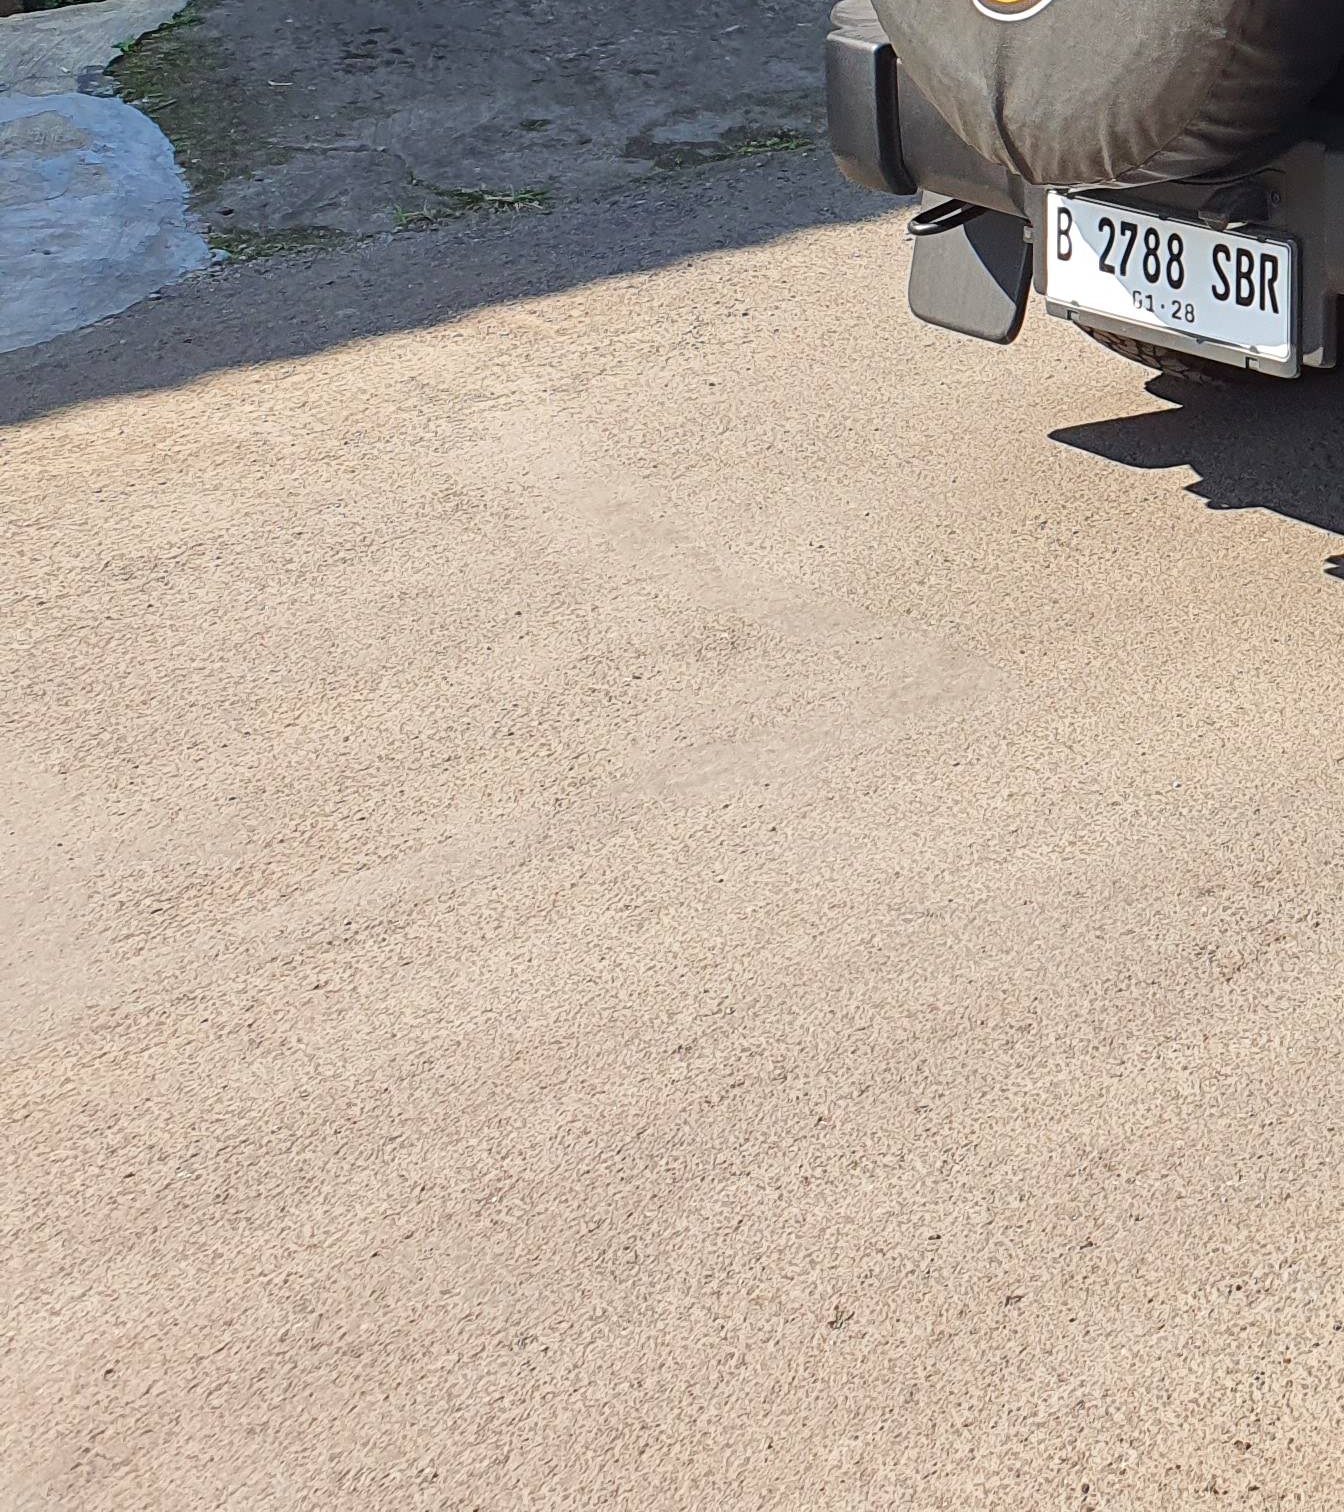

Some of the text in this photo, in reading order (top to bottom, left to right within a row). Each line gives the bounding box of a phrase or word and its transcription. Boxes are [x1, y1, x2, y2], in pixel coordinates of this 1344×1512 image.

[1057, 207, 1280, 314] B 2788 SBR
